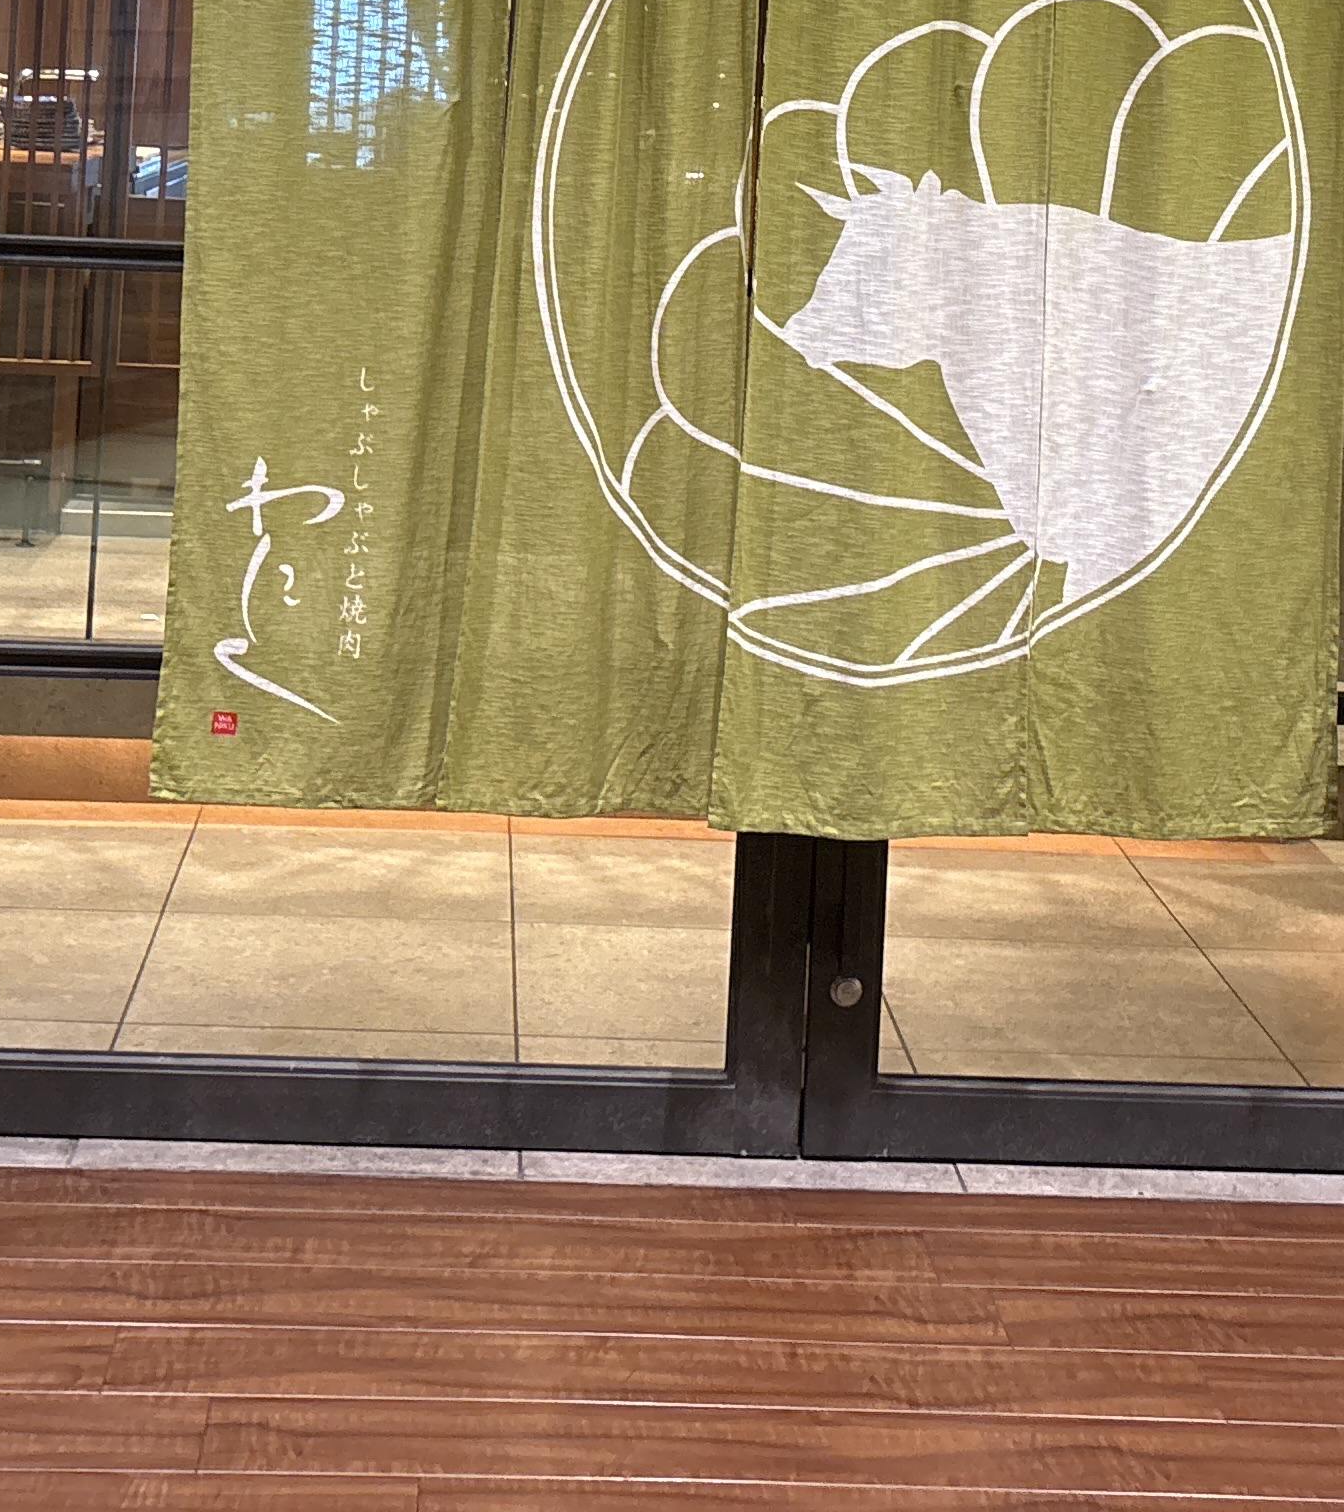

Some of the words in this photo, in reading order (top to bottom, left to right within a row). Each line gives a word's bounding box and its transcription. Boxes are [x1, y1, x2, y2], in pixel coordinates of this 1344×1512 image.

[214, 455, 346, 725] わにく
[338, 366, 380, 659] しゃぶしゃぶと焼肉
